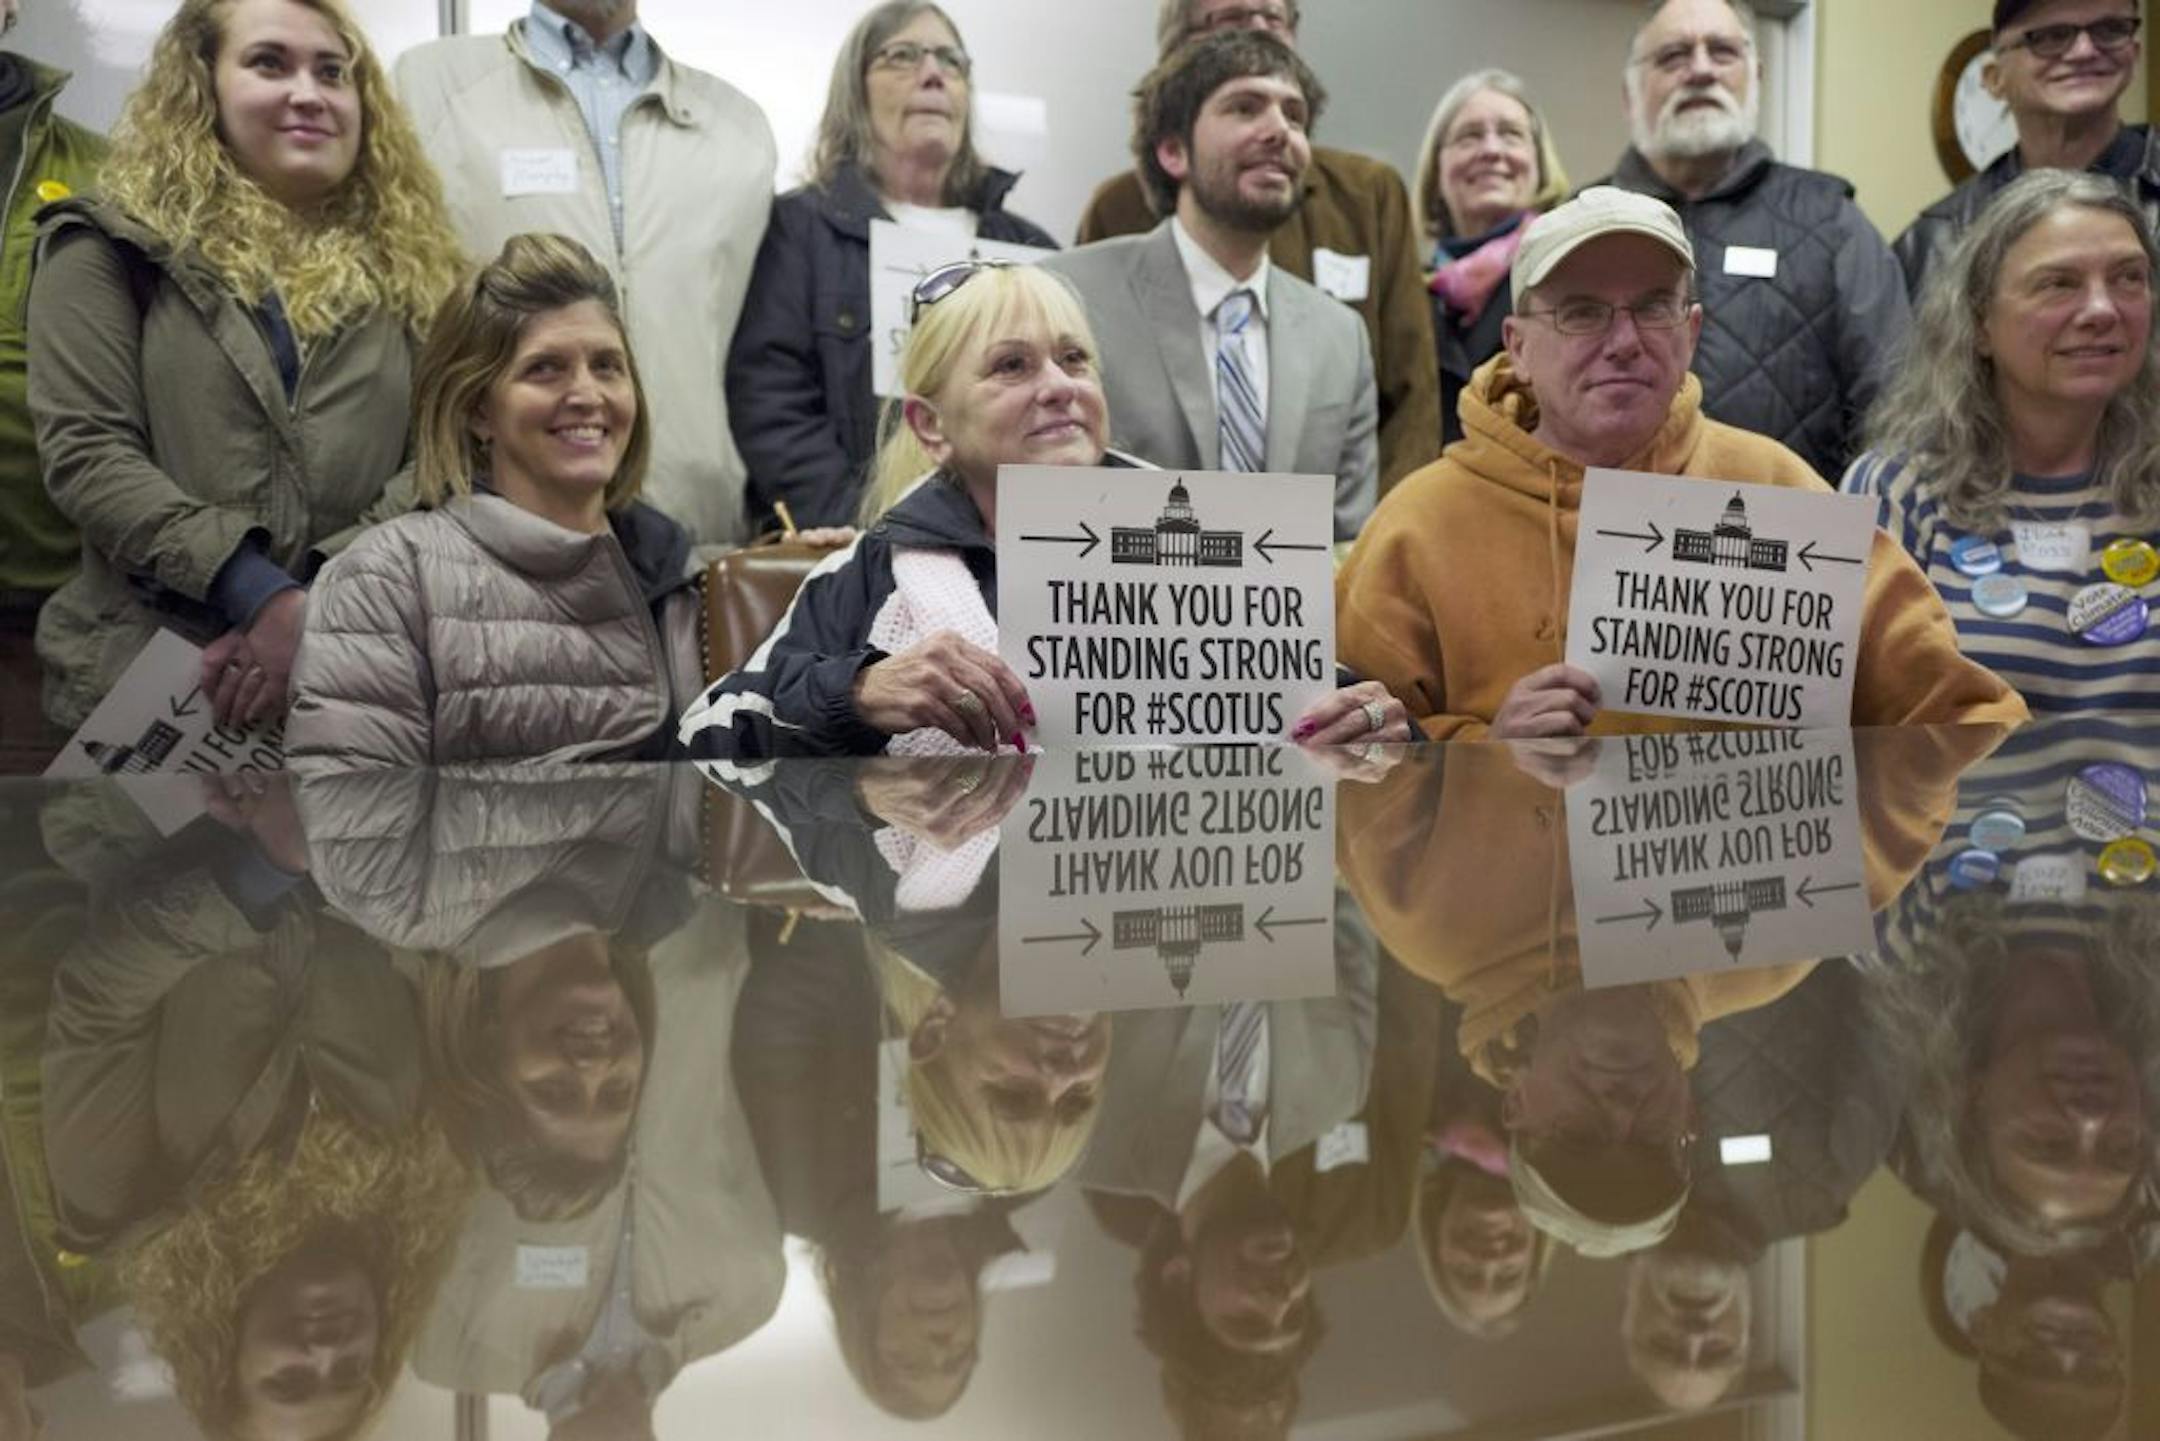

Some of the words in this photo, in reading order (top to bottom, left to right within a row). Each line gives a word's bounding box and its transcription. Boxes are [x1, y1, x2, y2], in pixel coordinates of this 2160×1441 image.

[1047, 580, 1159, 625] THANK
[1169, 584, 1232, 626] YOU
[1245, 586, 1304, 627] FOR
[1616, 570, 1710, 616] THANK
[1721, 582, 1773, 622] YOU
[1783, 590, 1833, 630] FOR
[1027, 636, 1188, 680] STANDING
[1200, 638, 1323, 680] STRONG
[1591, 617, 1730, 666] STANDING
[1738, 633, 1844, 677] STRONG
[1075, 692, 1135, 735] FOR
[1147, 692, 1283, 735] #SCOTUS
[1625, 668, 1679, 707] FOR
[1686, 676, 1803, 720] #SCOTUS
